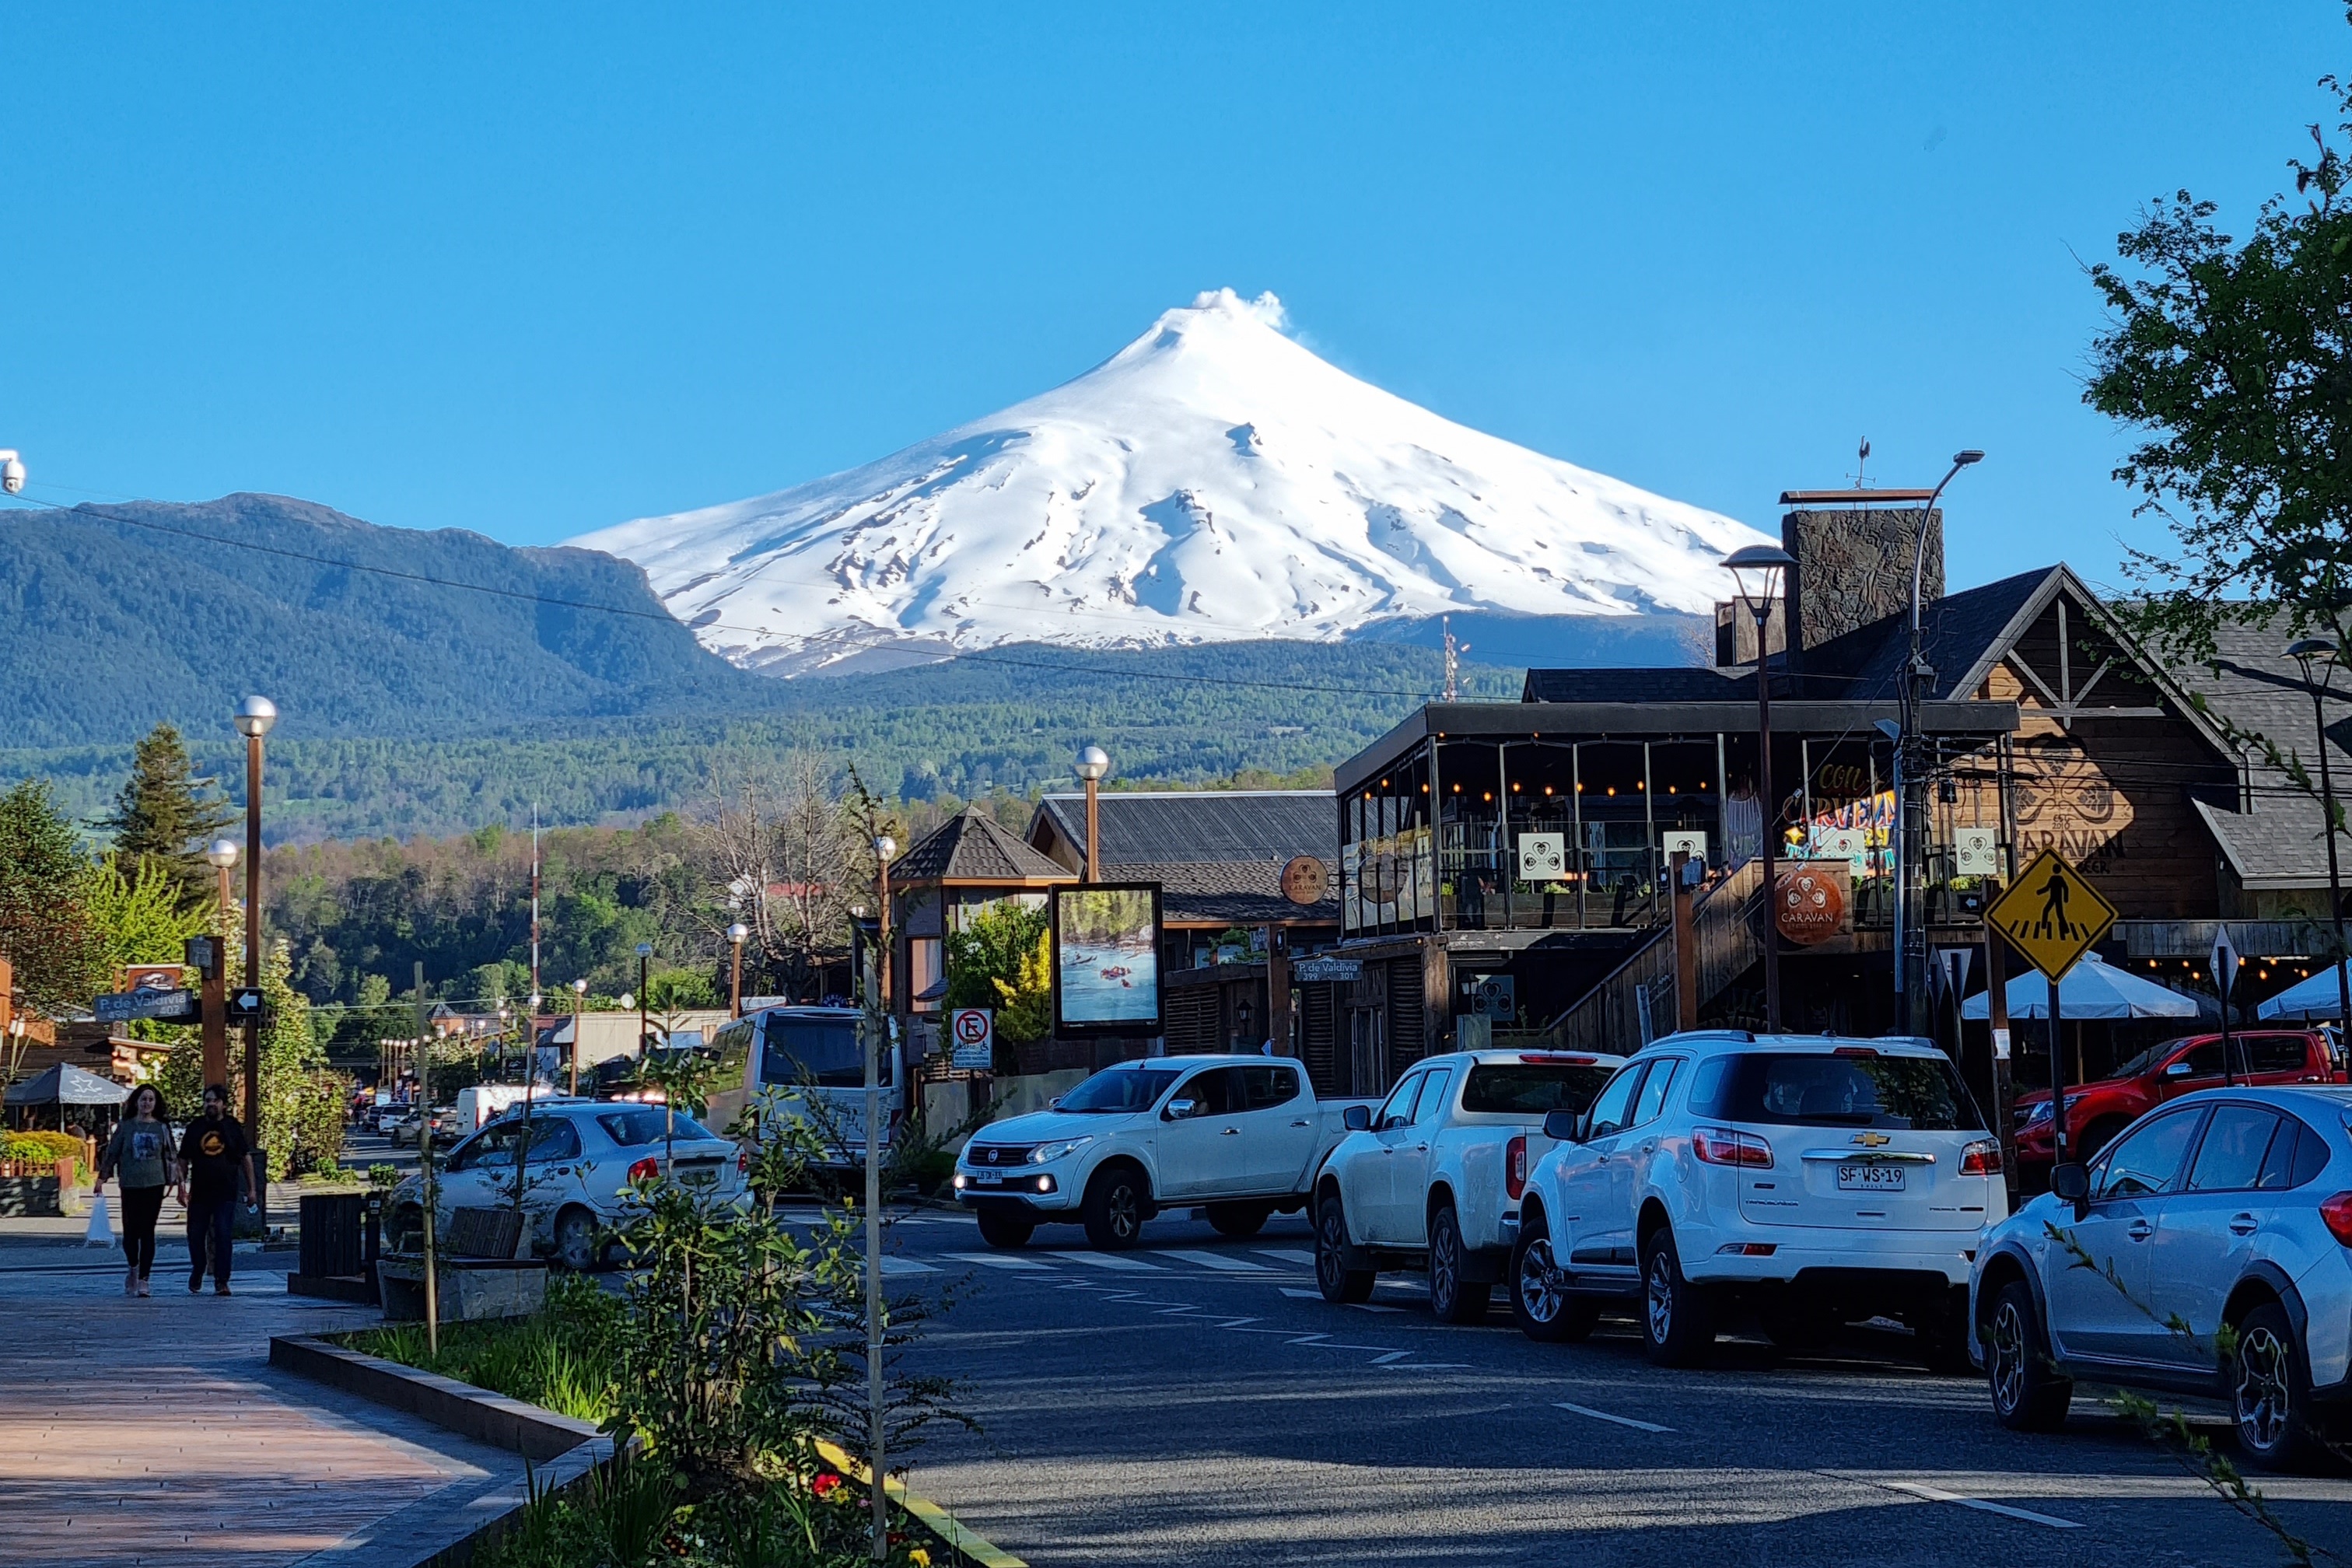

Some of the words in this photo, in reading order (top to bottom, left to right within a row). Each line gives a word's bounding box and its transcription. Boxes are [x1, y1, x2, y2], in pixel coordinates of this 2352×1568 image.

[2018, 830, 2126, 858] ARAVAN
[1781, 912, 1833, 923] CARAVAN
[1299, 964, 1307, 972] P.
[1308, 963, 1321, 972] de
[1322, 963, 1358, 972] Valdivia
[100, 999, 110, 1010] P.
[113, 998, 131, 1010] de
[133, 992, 187, 1007] Valdivia
